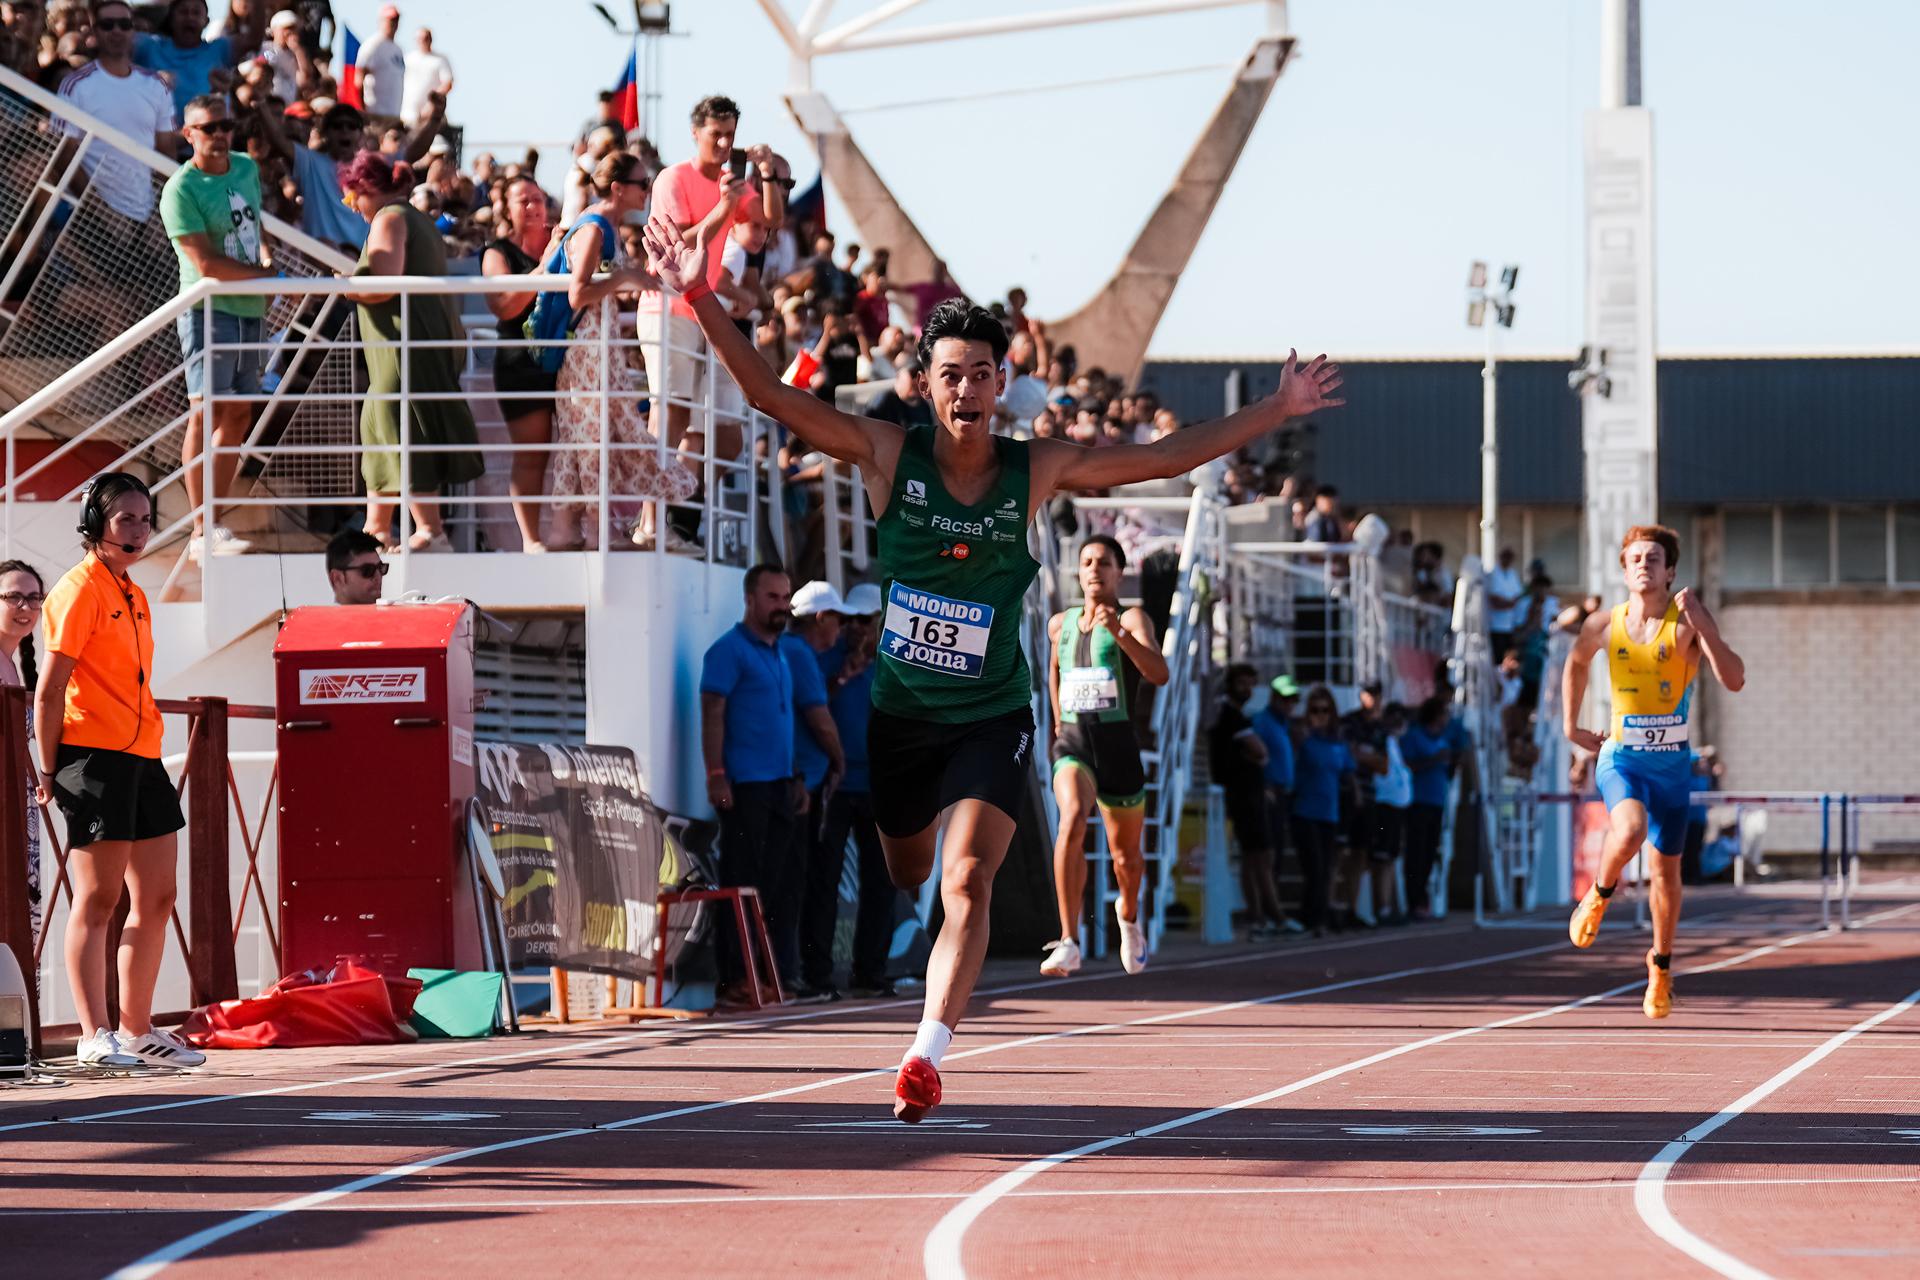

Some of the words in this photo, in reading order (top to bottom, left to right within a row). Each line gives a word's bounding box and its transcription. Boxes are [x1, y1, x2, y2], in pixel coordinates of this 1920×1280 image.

[931, 515, 983, 536] Facsa
[909, 593, 982, 622] MONDO
[908, 616, 959, 648] 163
[346, 673, 418, 690] RFEA
[342, 690, 411, 698] ATLETISMO
[1636, 716, 1683, 726] MONDO
[1645, 729, 1666, 744] 97
